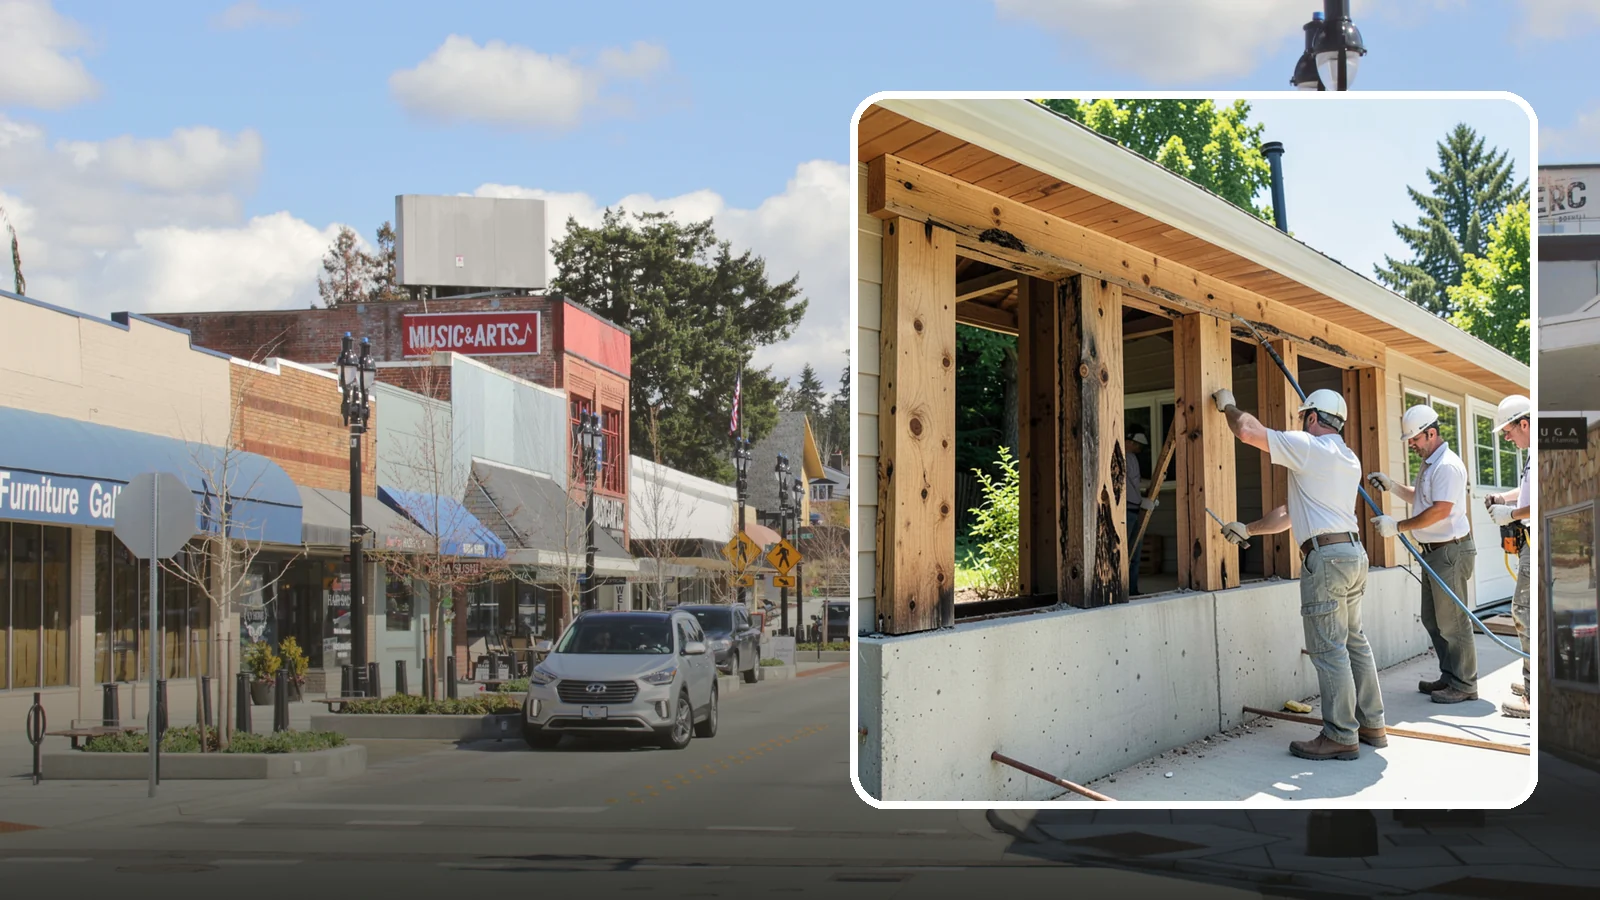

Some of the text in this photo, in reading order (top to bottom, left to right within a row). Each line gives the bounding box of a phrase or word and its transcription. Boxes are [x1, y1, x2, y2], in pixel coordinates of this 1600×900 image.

[409, 323, 520, 349] MUSIC&ARTS
[1540, 427, 1577, 437] UGA
[0, 471, 122, 519] Furniture Gal
